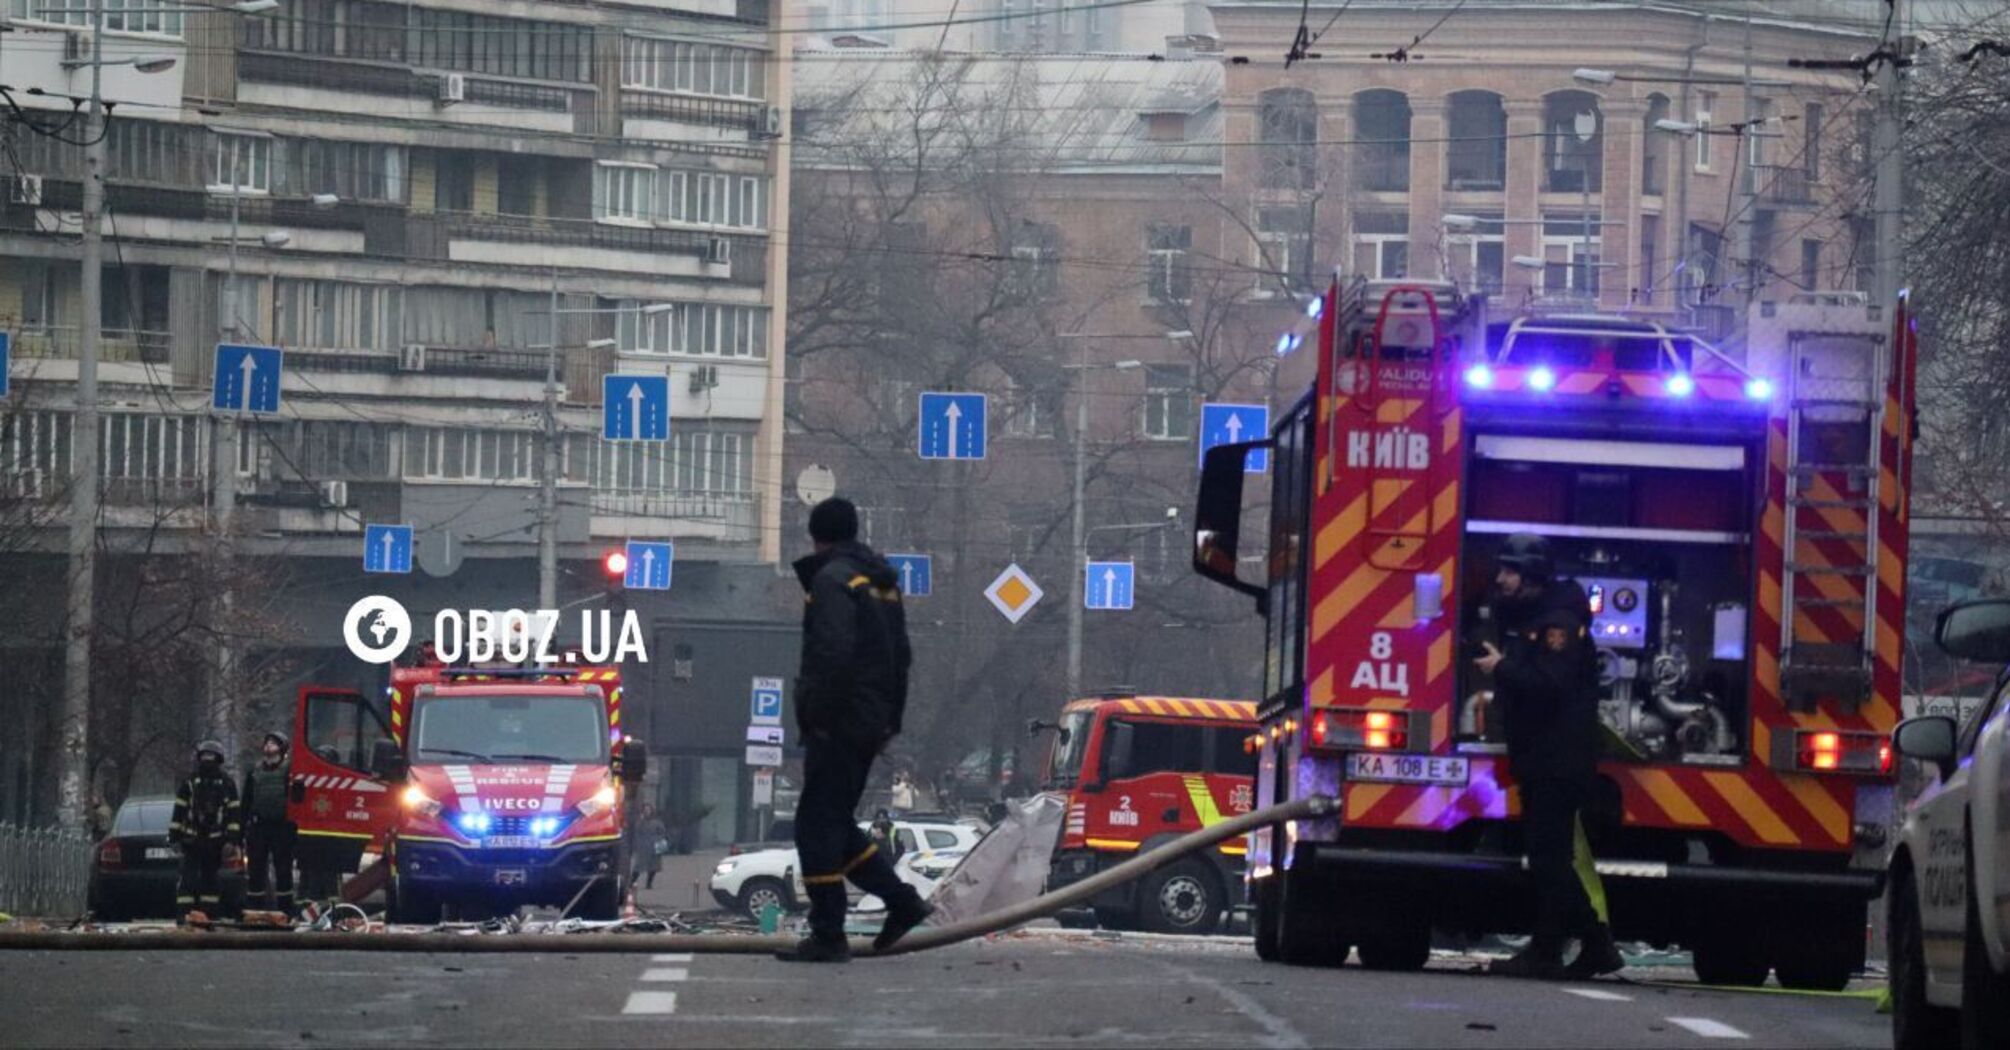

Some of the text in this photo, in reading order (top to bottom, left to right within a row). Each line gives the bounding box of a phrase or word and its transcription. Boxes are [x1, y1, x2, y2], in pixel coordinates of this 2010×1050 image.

[1347, 426, 1430, 469] КИЇВ
[1370, 632, 1392, 659] 8
[1351, 661, 1409, 696] АЦ
[758, 693, 777, 713] P
[1357, 756, 1384, 775] KA
[1393, 759, 1422, 777] 108
[355, 796, 365, 808] 2
[484, 798, 540, 810] IVECO
[1119, 796, 1131, 809] 2
[1109, 810, 1139, 827] КИЇВ
